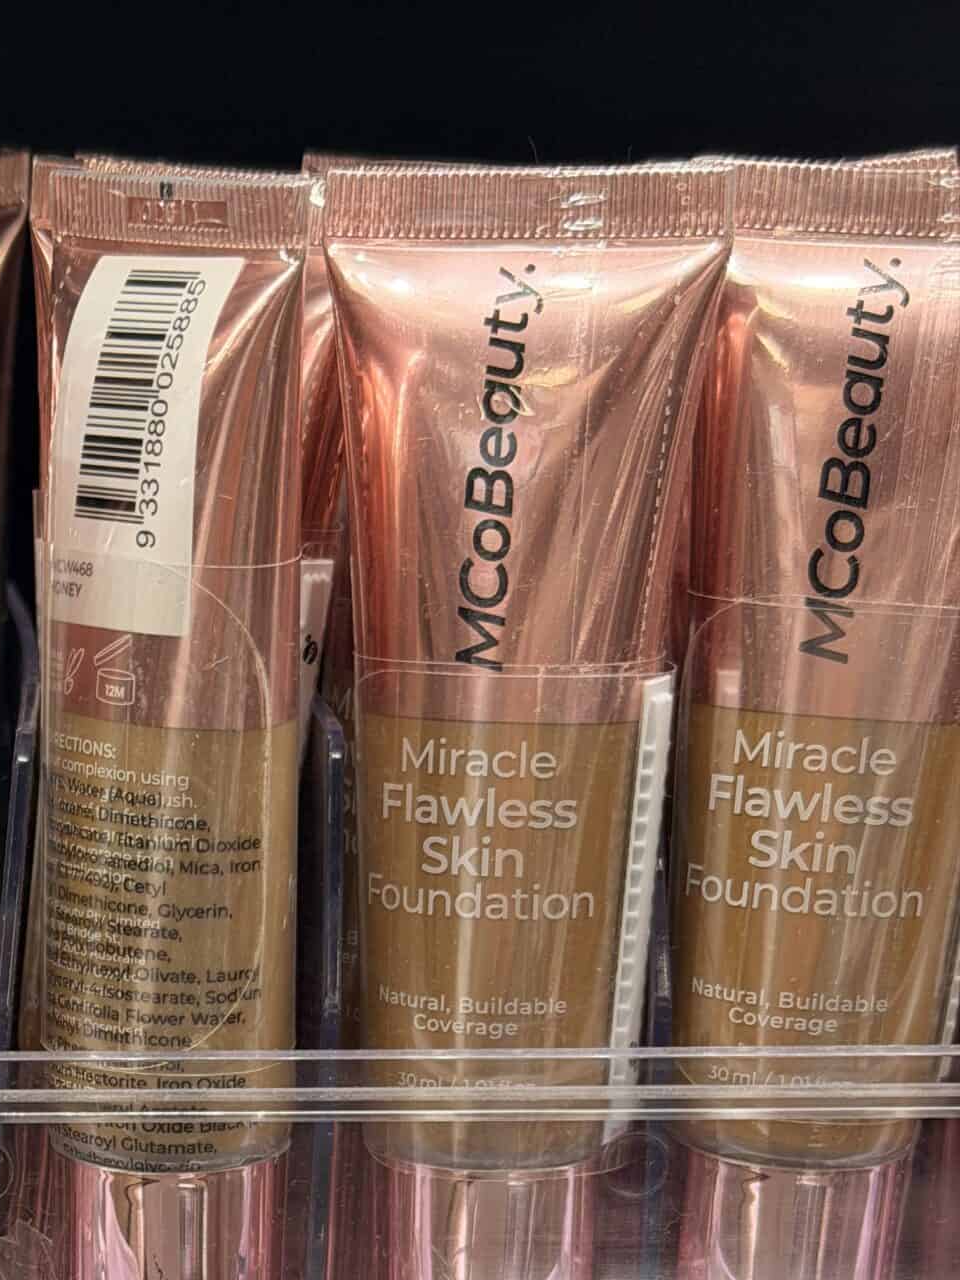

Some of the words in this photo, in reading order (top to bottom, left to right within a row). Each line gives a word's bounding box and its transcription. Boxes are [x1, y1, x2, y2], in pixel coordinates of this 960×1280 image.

[157, 279, 206, 390] 025885
[139, 399, 168, 516] 331880
[136, 530, 156, 548] 9
[401, 736, 557, 780] Miracle
[733, 728, 897, 775] Miracle
[62, 758, 137, 784] complexion
[141, 771, 190, 791] using
[382, 782, 578, 830] Flawless
[708, 774, 915, 826] Flawless
[195, 836, 261, 854] Dioxide
[421, 836, 524, 878] Skin
[748, 829, 857, 874] Skin
[178, 860, 224, 877] Mica,
[123, 877, 167, 897] Cetyl
[368, 872, 594, 920] Foundation
[686, 863, 924, 918] Foundation
[157, 902, 233, 922] Glycerin,
[107, 918, 183, 943] Stearate,
[136, 966, 201, 985] Olivate,
[379, 984, 451, 1017] Natural,
[459, 994, 567, 1017] Buildable
[691, 976, 770, 1010] Natural,
[778, 990, 888, 1014] Buildable
[125, 1008, 186, 1027] Flower
[191, 1010, 246, 1028] Water,
[413, 1013, 519, 1038] Coverage
[728, 1006, 839, 1034] Coverage
[120, 1136, 218, 1156] Glutamate,
